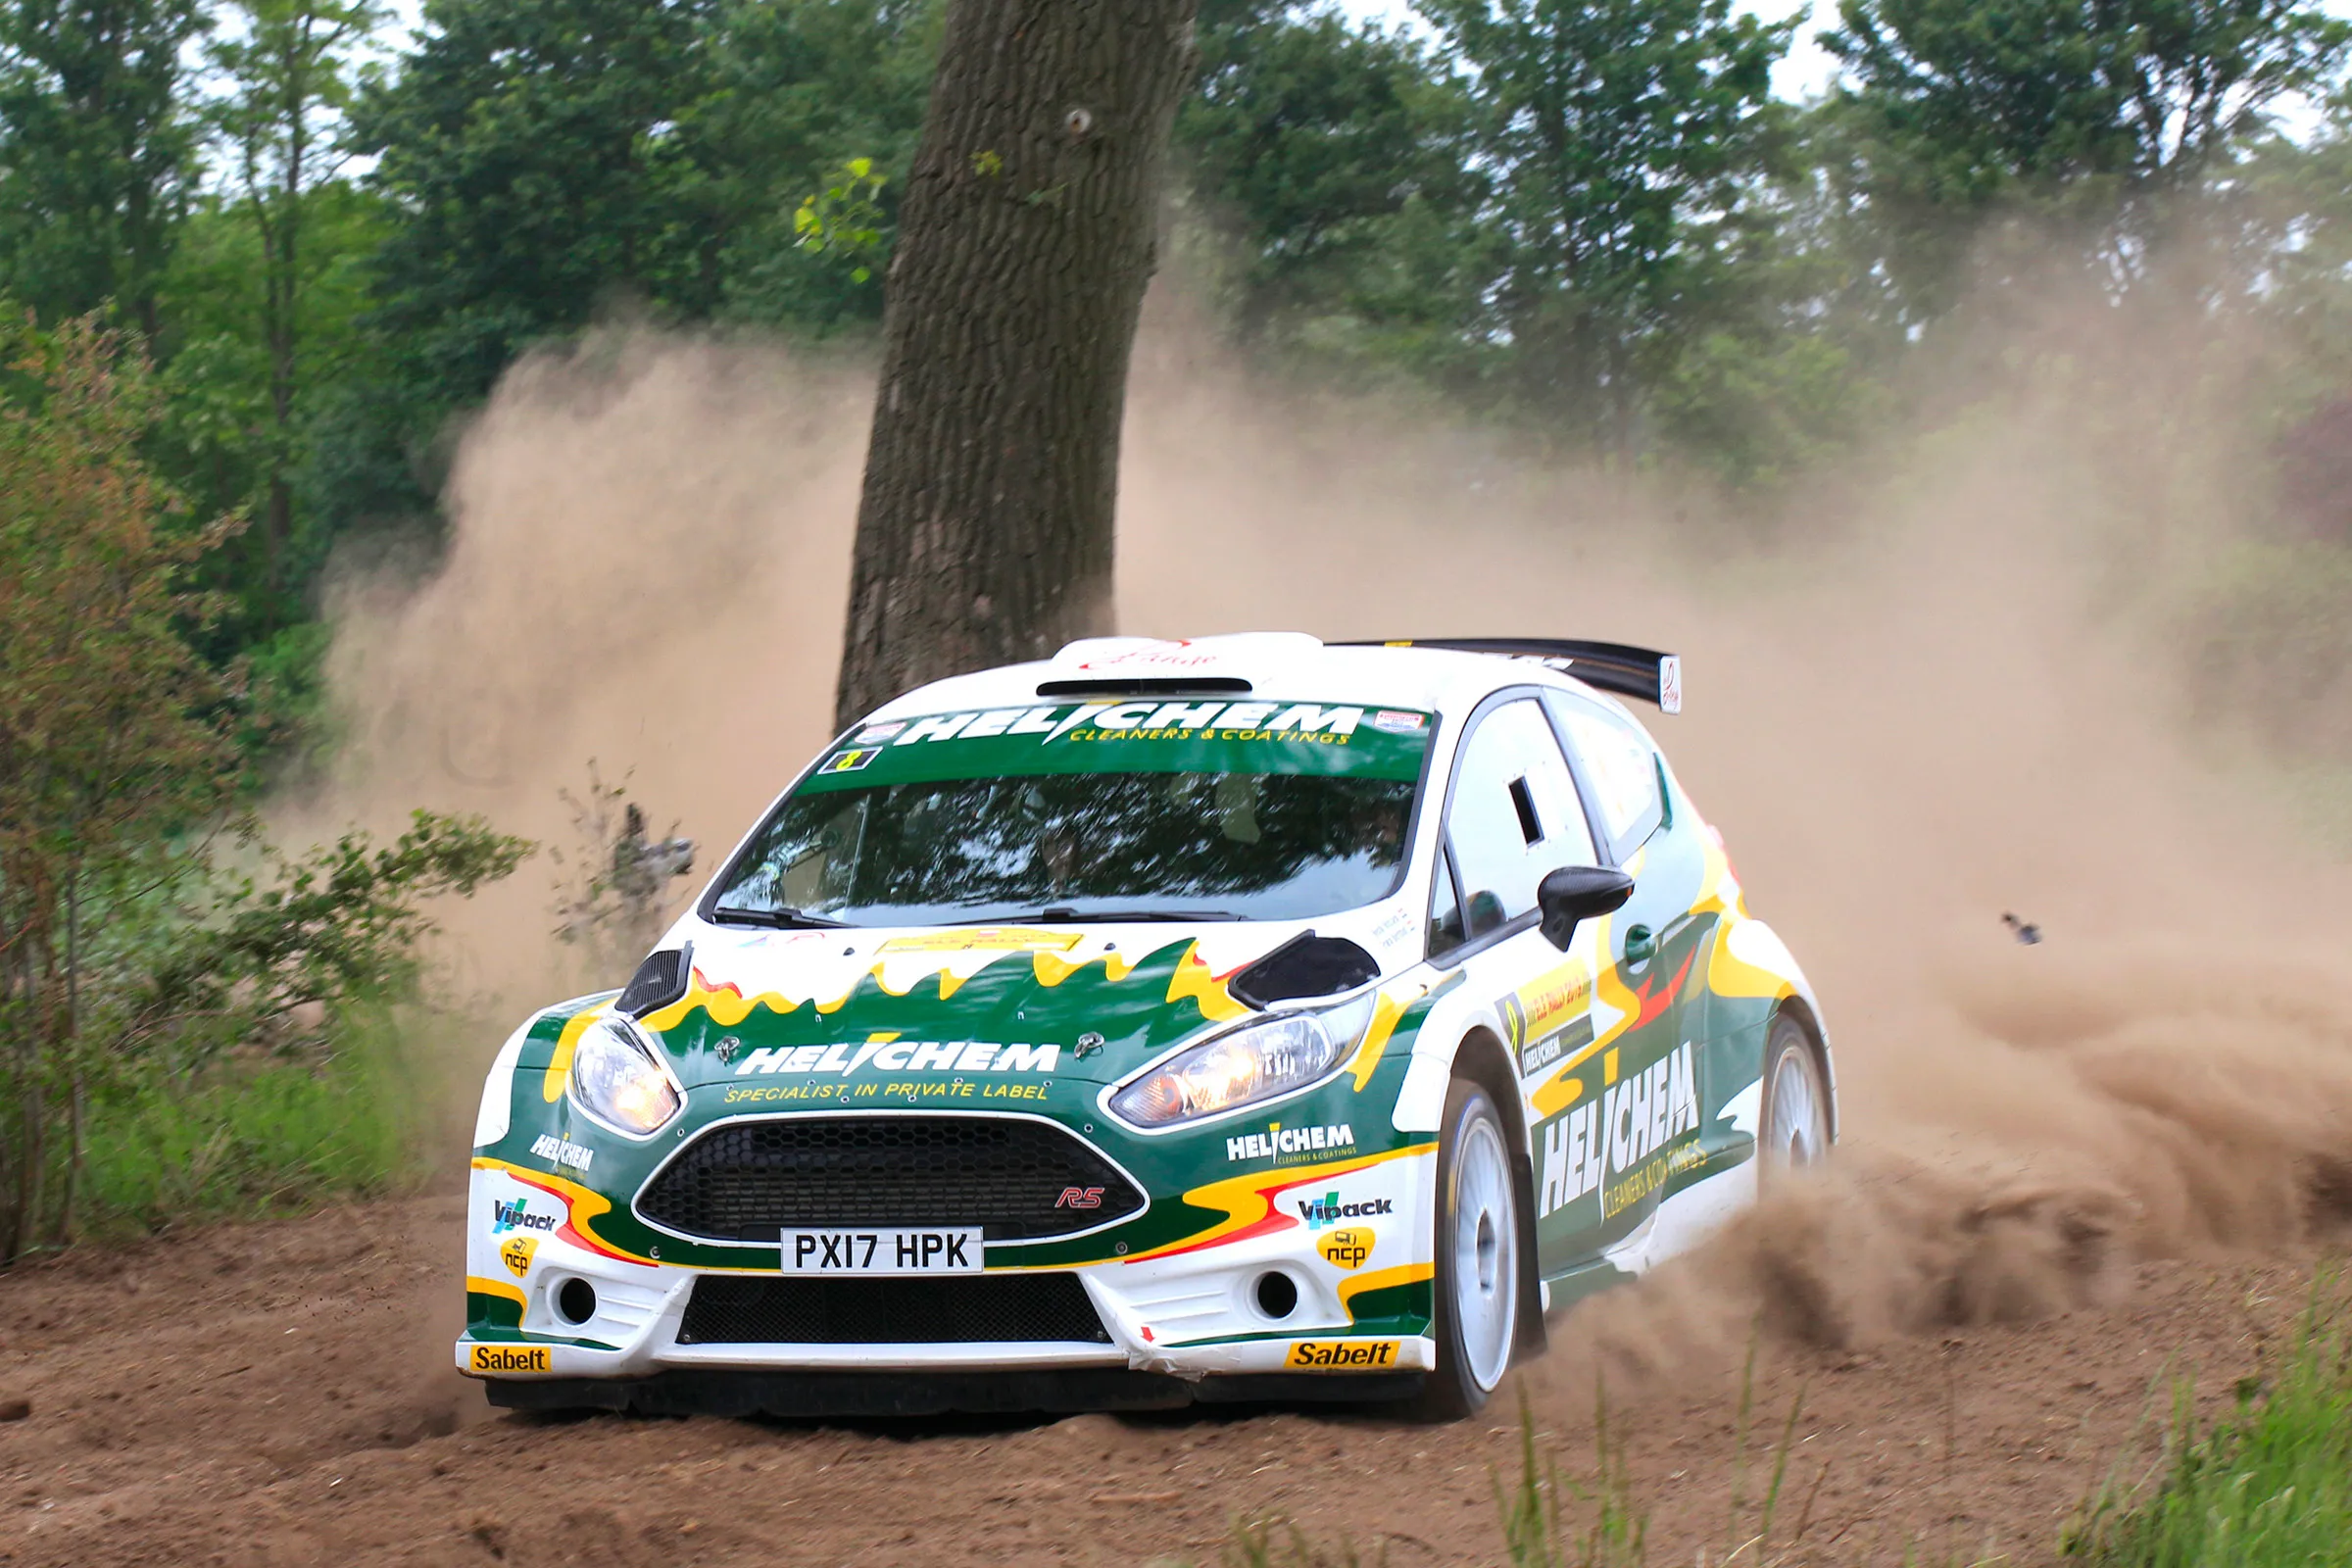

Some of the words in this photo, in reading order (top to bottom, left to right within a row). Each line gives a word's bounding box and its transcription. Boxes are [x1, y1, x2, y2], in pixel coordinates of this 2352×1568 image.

[1069, 728, 1189, 741] CLEANERS
[1200, 728, 1214, 740] &
[1221, 728, 1350, 745] COATINGS
[836, 750, 862, 771] 8
[724, 1084, 848, 1103] SPECIALIST
[855, 1083, 878, 1097] IN
[885, 1083, 975, 1098] PRIVATE
[983, 1085, 1048, 1101] LABEL
[1277, 1154, 1310, 1164] CLEANERS
[1318, 1147, 1357, 1160] COATINGS
[1054, 1187, 1105, 1208] RS
[494, 1198, 557, 1232] Vipack
[1298, 1195, 1393, 1222] Vipack
[795, 1234, 878, 1268] PX17
[896, 1233, 968, 1267] HPK
[1327, 1247, 1365, 1267] ncp
[475, 1347, 545, 1370] Sabelt
[1294, 1342, 1391, 1365] Sabelt
